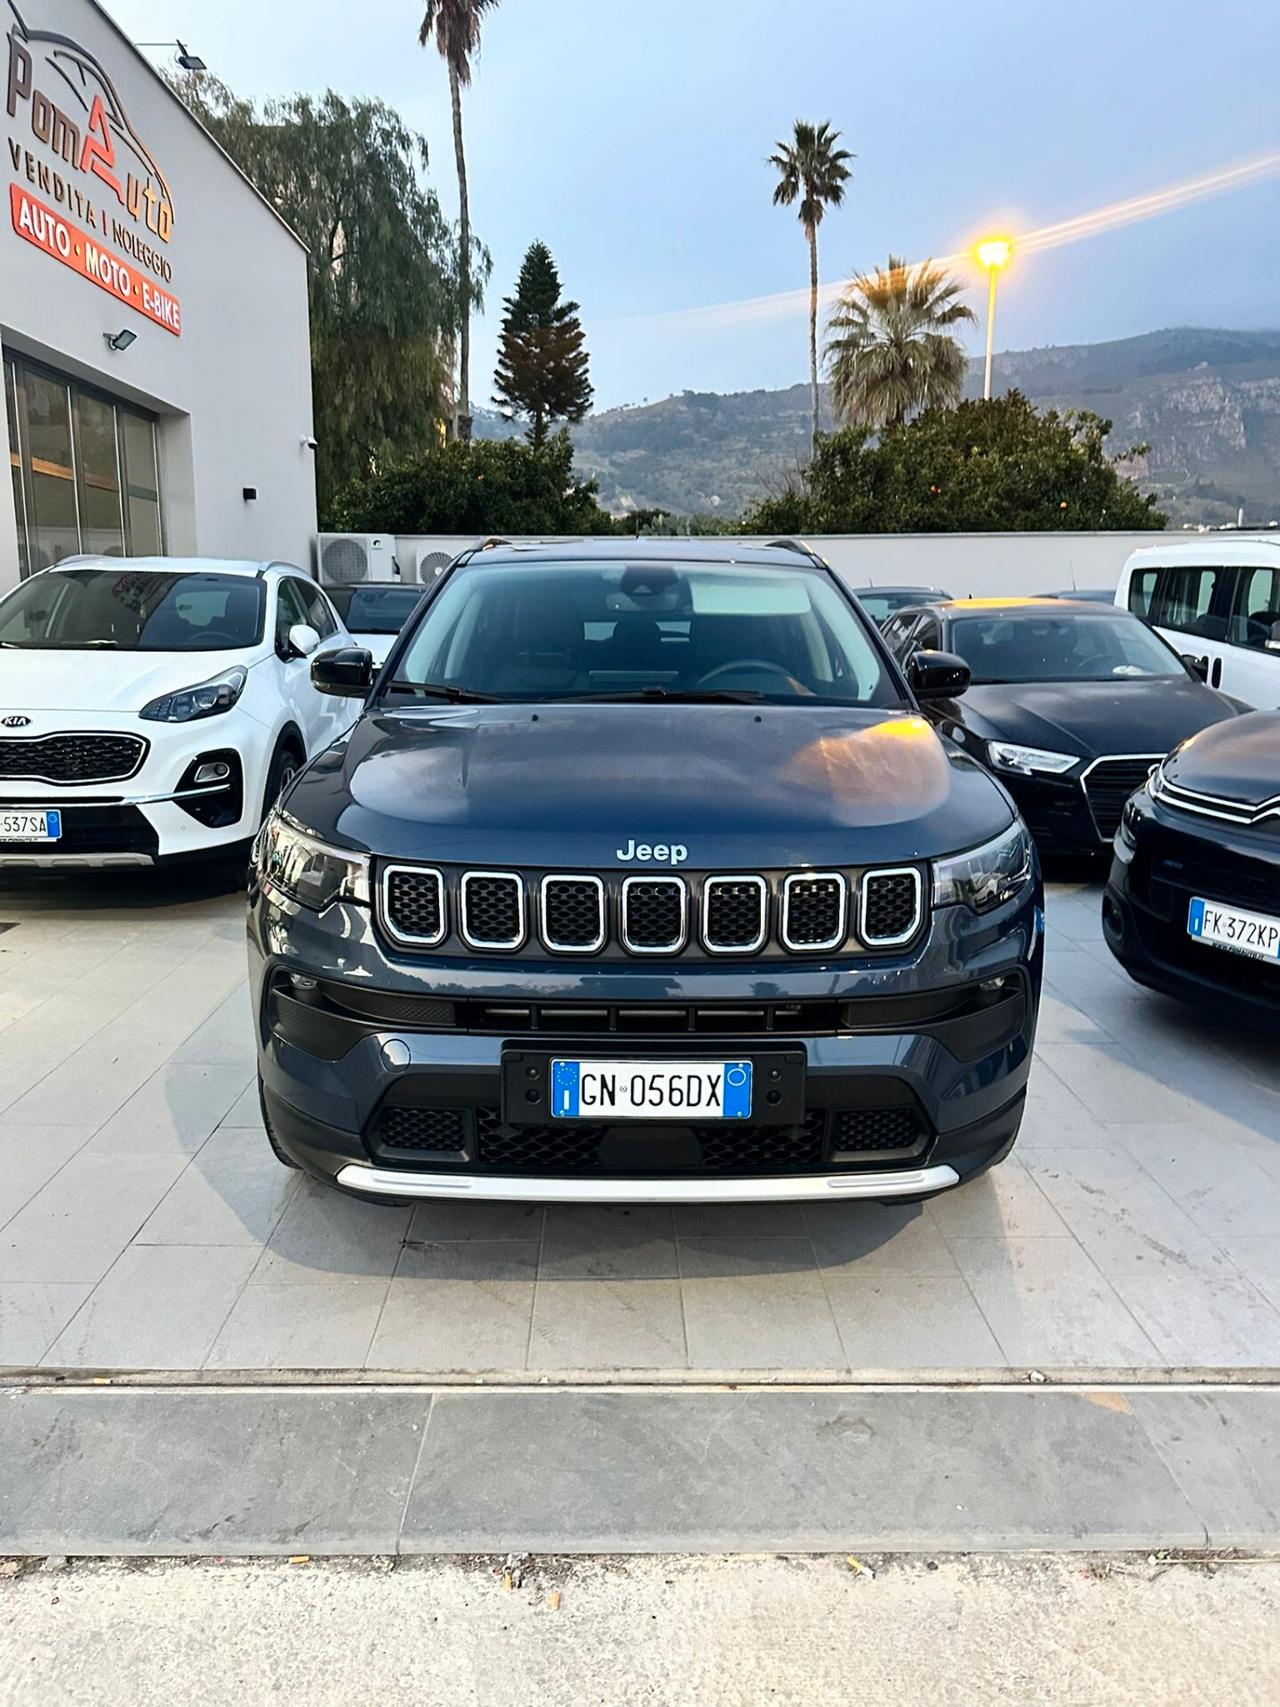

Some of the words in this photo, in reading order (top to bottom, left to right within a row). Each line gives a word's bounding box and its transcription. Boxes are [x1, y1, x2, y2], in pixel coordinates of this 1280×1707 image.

[8, 136, 97, 229] VENDITA
[112, 218, 173, 284] NOLEGGIO
[18, 196, 71, 258] AUTO
[85, 240, 131, 297] MOTO
[141, 280, 180, 330] E-BIKE
[4, 716, 27, 726] KIA
[3, 816, 47, 833] 537SA
[616, 839, 688, 865] Jeep
[1204, 911, 1221, 934] FK
[1227, 917, 1278, 948] 372KP
[581, 1073, 616, 1107] GN
[630, 1074, 722, 1107] 056DX
